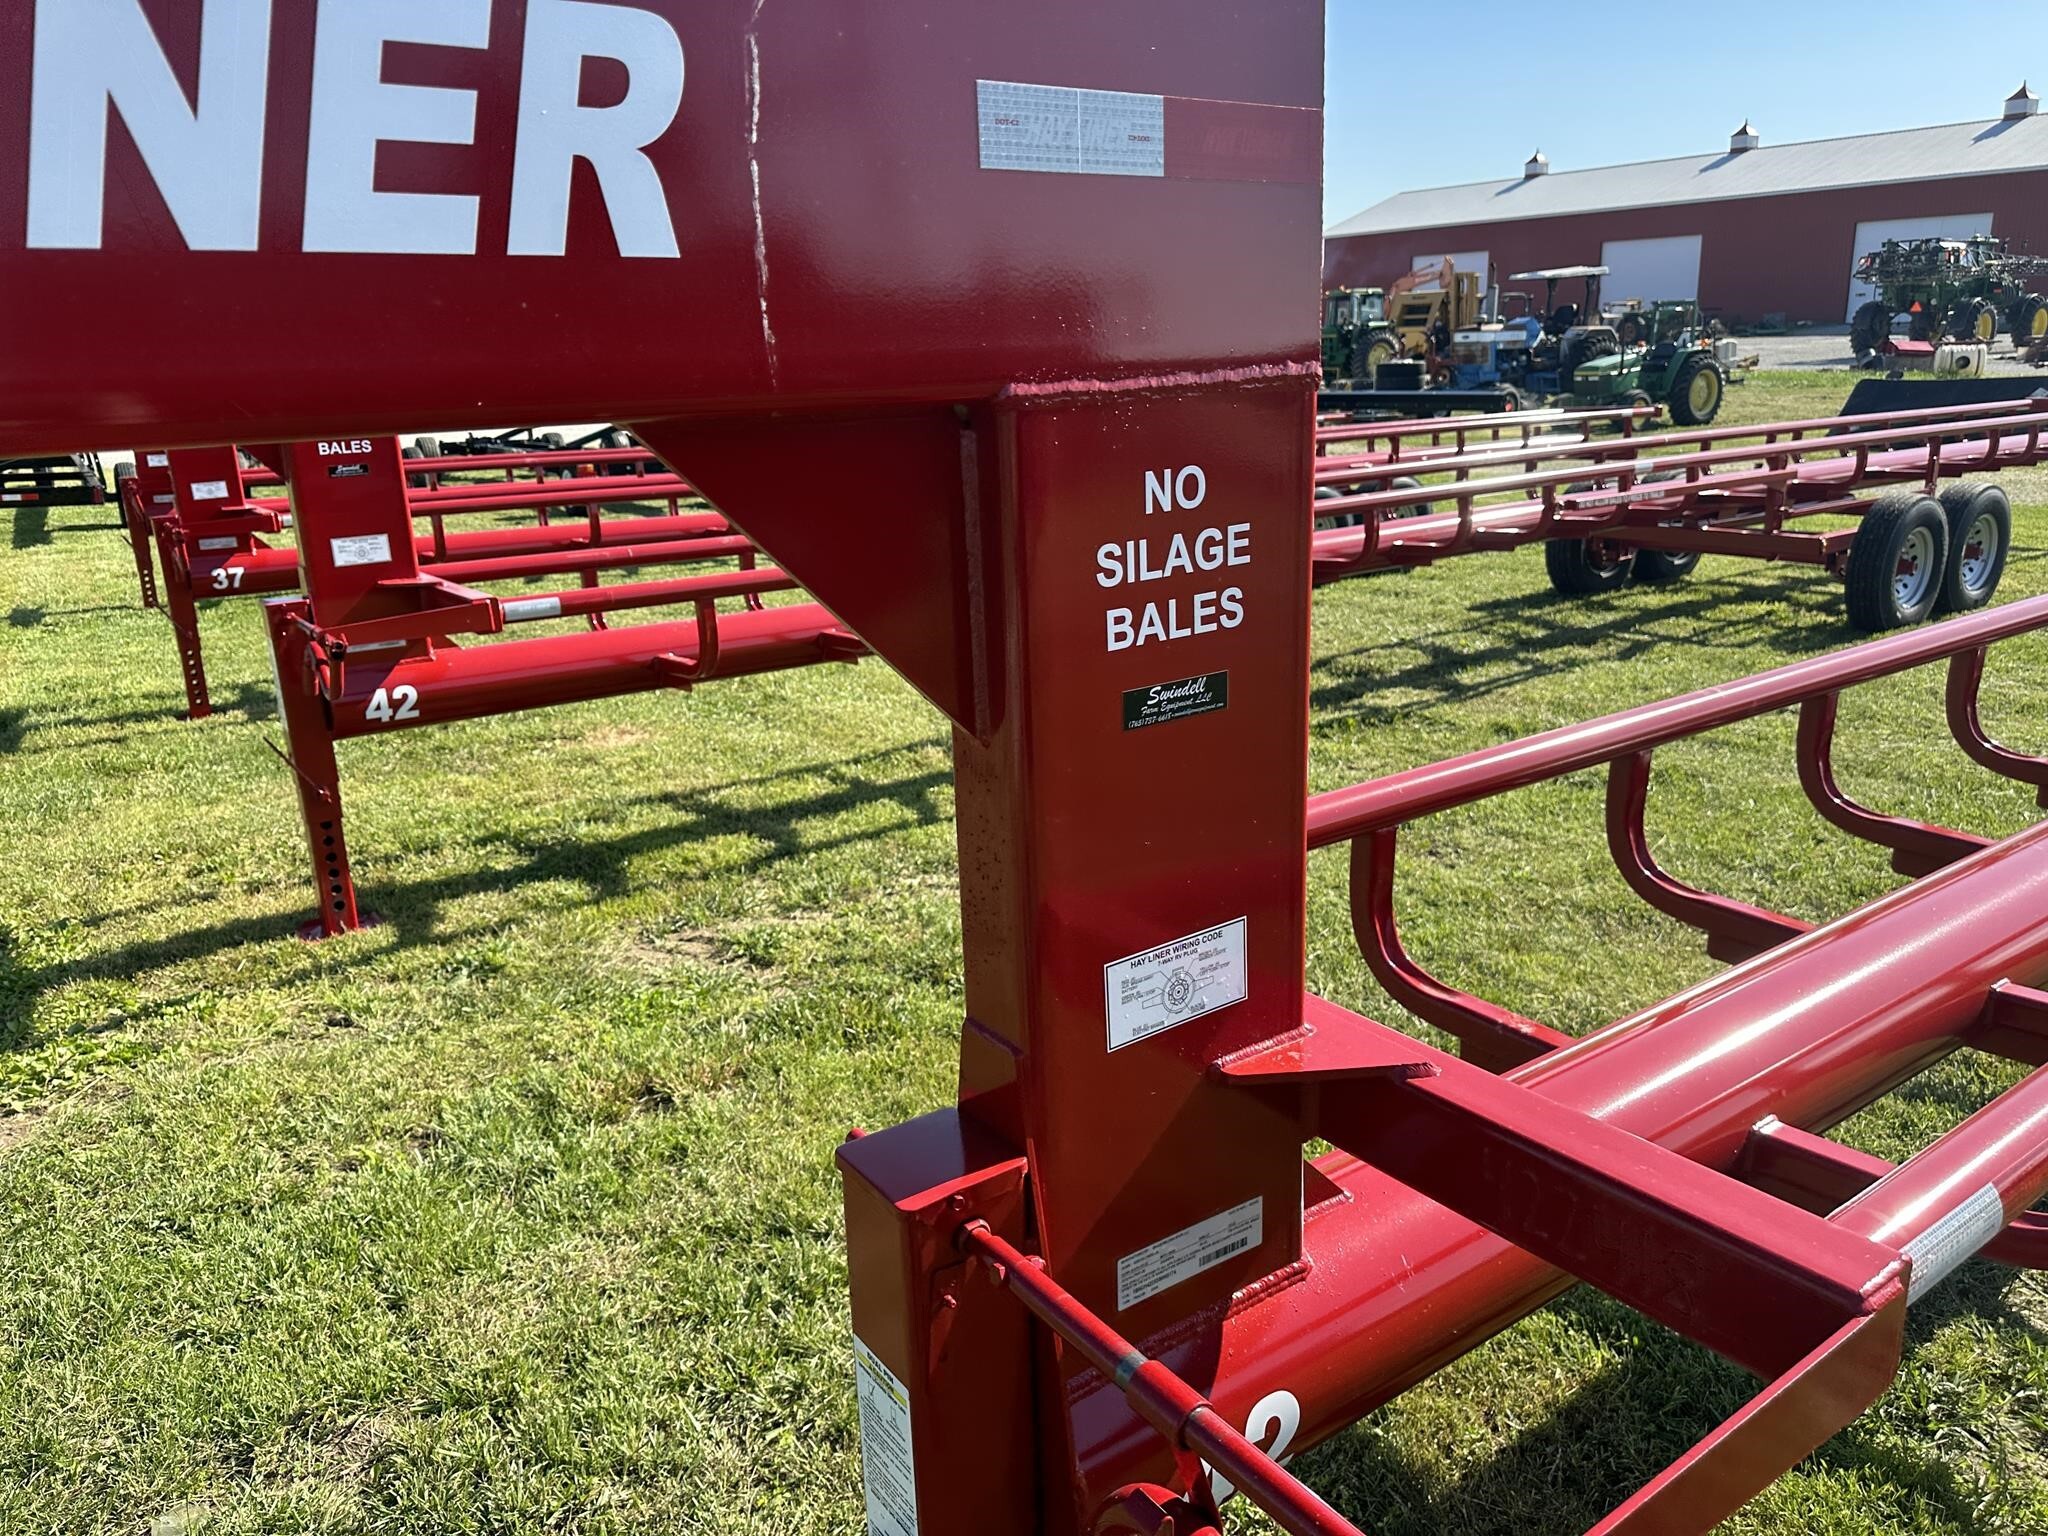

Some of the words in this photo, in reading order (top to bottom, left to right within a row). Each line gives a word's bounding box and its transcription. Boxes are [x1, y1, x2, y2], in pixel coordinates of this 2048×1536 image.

[26, 0, 685, 258] NER
[317, 440, 373, 456] BALES
[1145, 465, 1206, 514] NO
[1096, 522, 1251, 588] SILAGE
[211, 566, 245, 590] 37
[1106, 586, 1244, 652] BALES
[365, 684, 420, 722] 42
[1147, 676, 1206, 705] Swindell
[1195, 691, 1212, 703] LLC
[1130, 957, 1146, 969] HAY
[1148, 949, 1171, 963] LINER
[1172, 938, 1200, 954] WIRING
[1202, 930, 1223, 944] CODE
[1174, 953, 1183, 961] RV
[1183, 948, 1199, 958] PLUG
